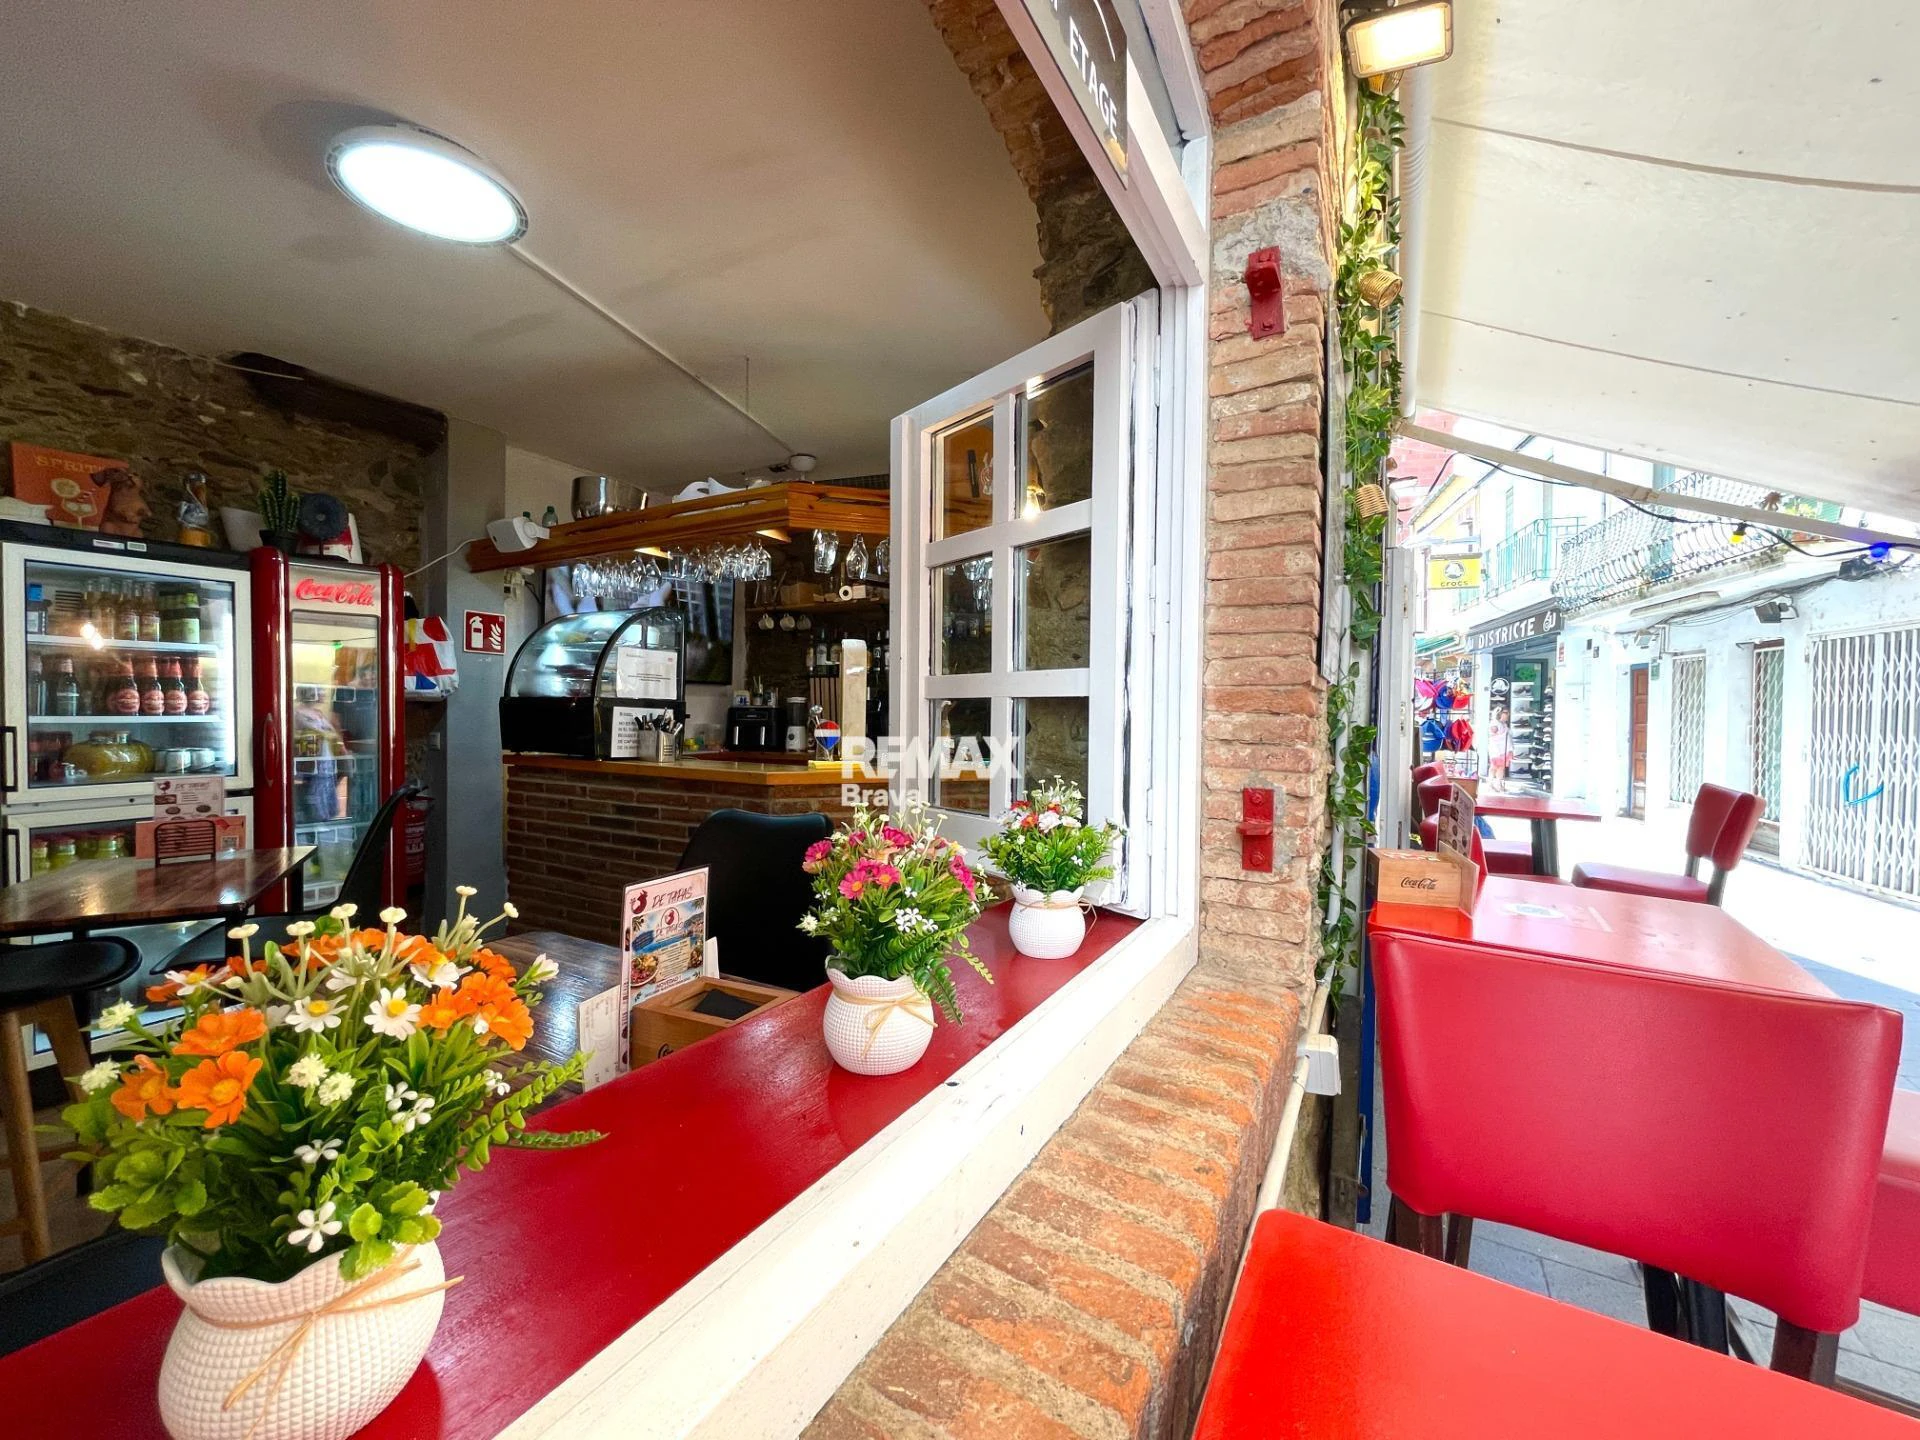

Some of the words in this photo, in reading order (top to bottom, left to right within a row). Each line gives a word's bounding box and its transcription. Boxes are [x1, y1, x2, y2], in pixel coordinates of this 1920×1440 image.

[1440, 580, 1469, 588] crocs
[1478, 616, 1537, 650] DISTRICTE
[652, 893, 666, 909] DE
